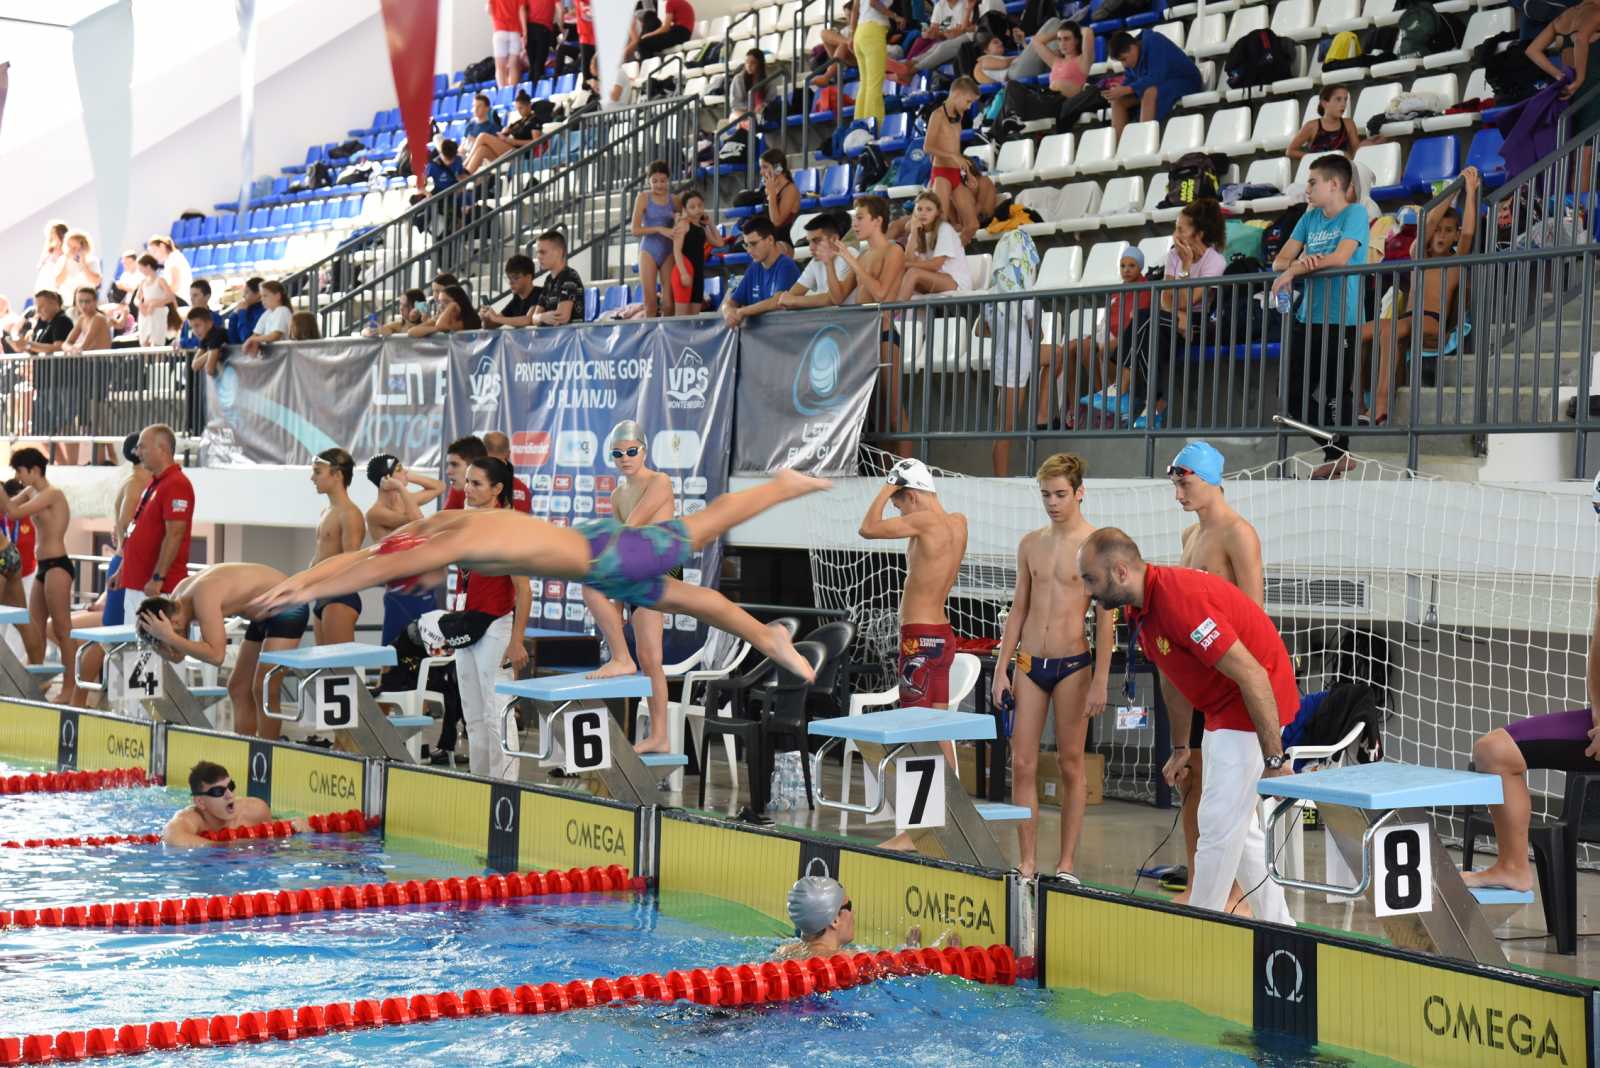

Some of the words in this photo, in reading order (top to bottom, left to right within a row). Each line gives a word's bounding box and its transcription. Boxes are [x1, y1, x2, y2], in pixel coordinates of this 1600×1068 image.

[617, 358, 653, 380] GORE
[668, 366, 710, 394] VPS
[323, 677, 351, 726] 5
[106, 734, 145, 760] OMEGA
[572, 712, 603, 768] 6
[308, 769, 357, 801] OMEGA
[905, 759, 936, 825] 7
[566, 818, 627, 857] OMEGA
[1384, 829, 1422, 911] 8
[905, 885, 996, 935] OMEGA
[1423, 995, 1569, 1067] OMEGA
